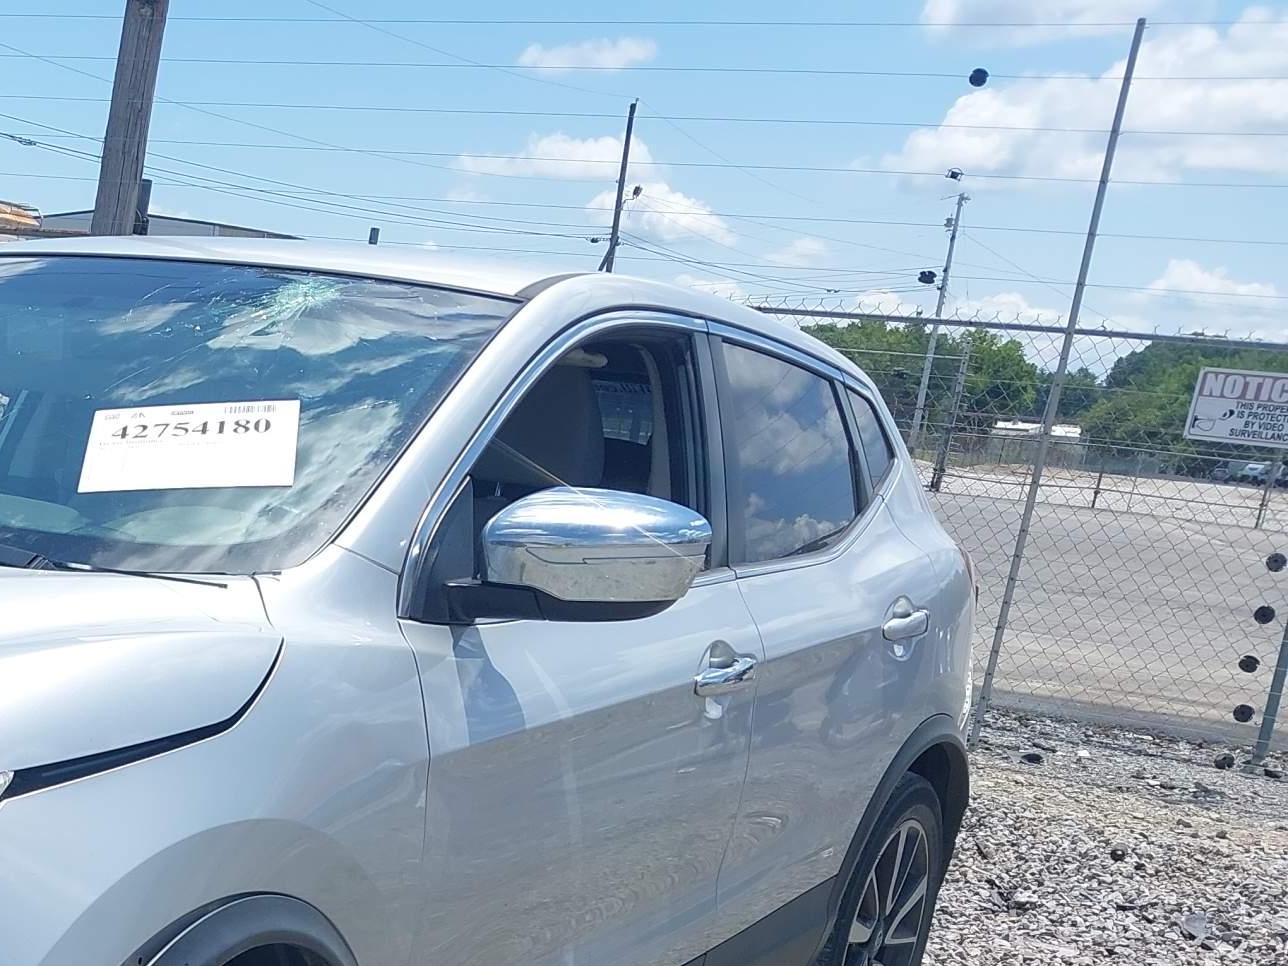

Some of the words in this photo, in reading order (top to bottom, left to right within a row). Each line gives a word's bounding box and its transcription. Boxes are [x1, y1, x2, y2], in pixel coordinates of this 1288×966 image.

[1235, 401, 1254, 410] THIS
[1256, 403, 1288, 413] PROPE
[1237, 410, 1246, 419] IS
[1247, 411, 1288, 422] PROTECT
[112, 418, 272, 440] 42754180
[1244, 420, 1257, 429] BY
[1258, 421, 1285, 432] VIDEO
